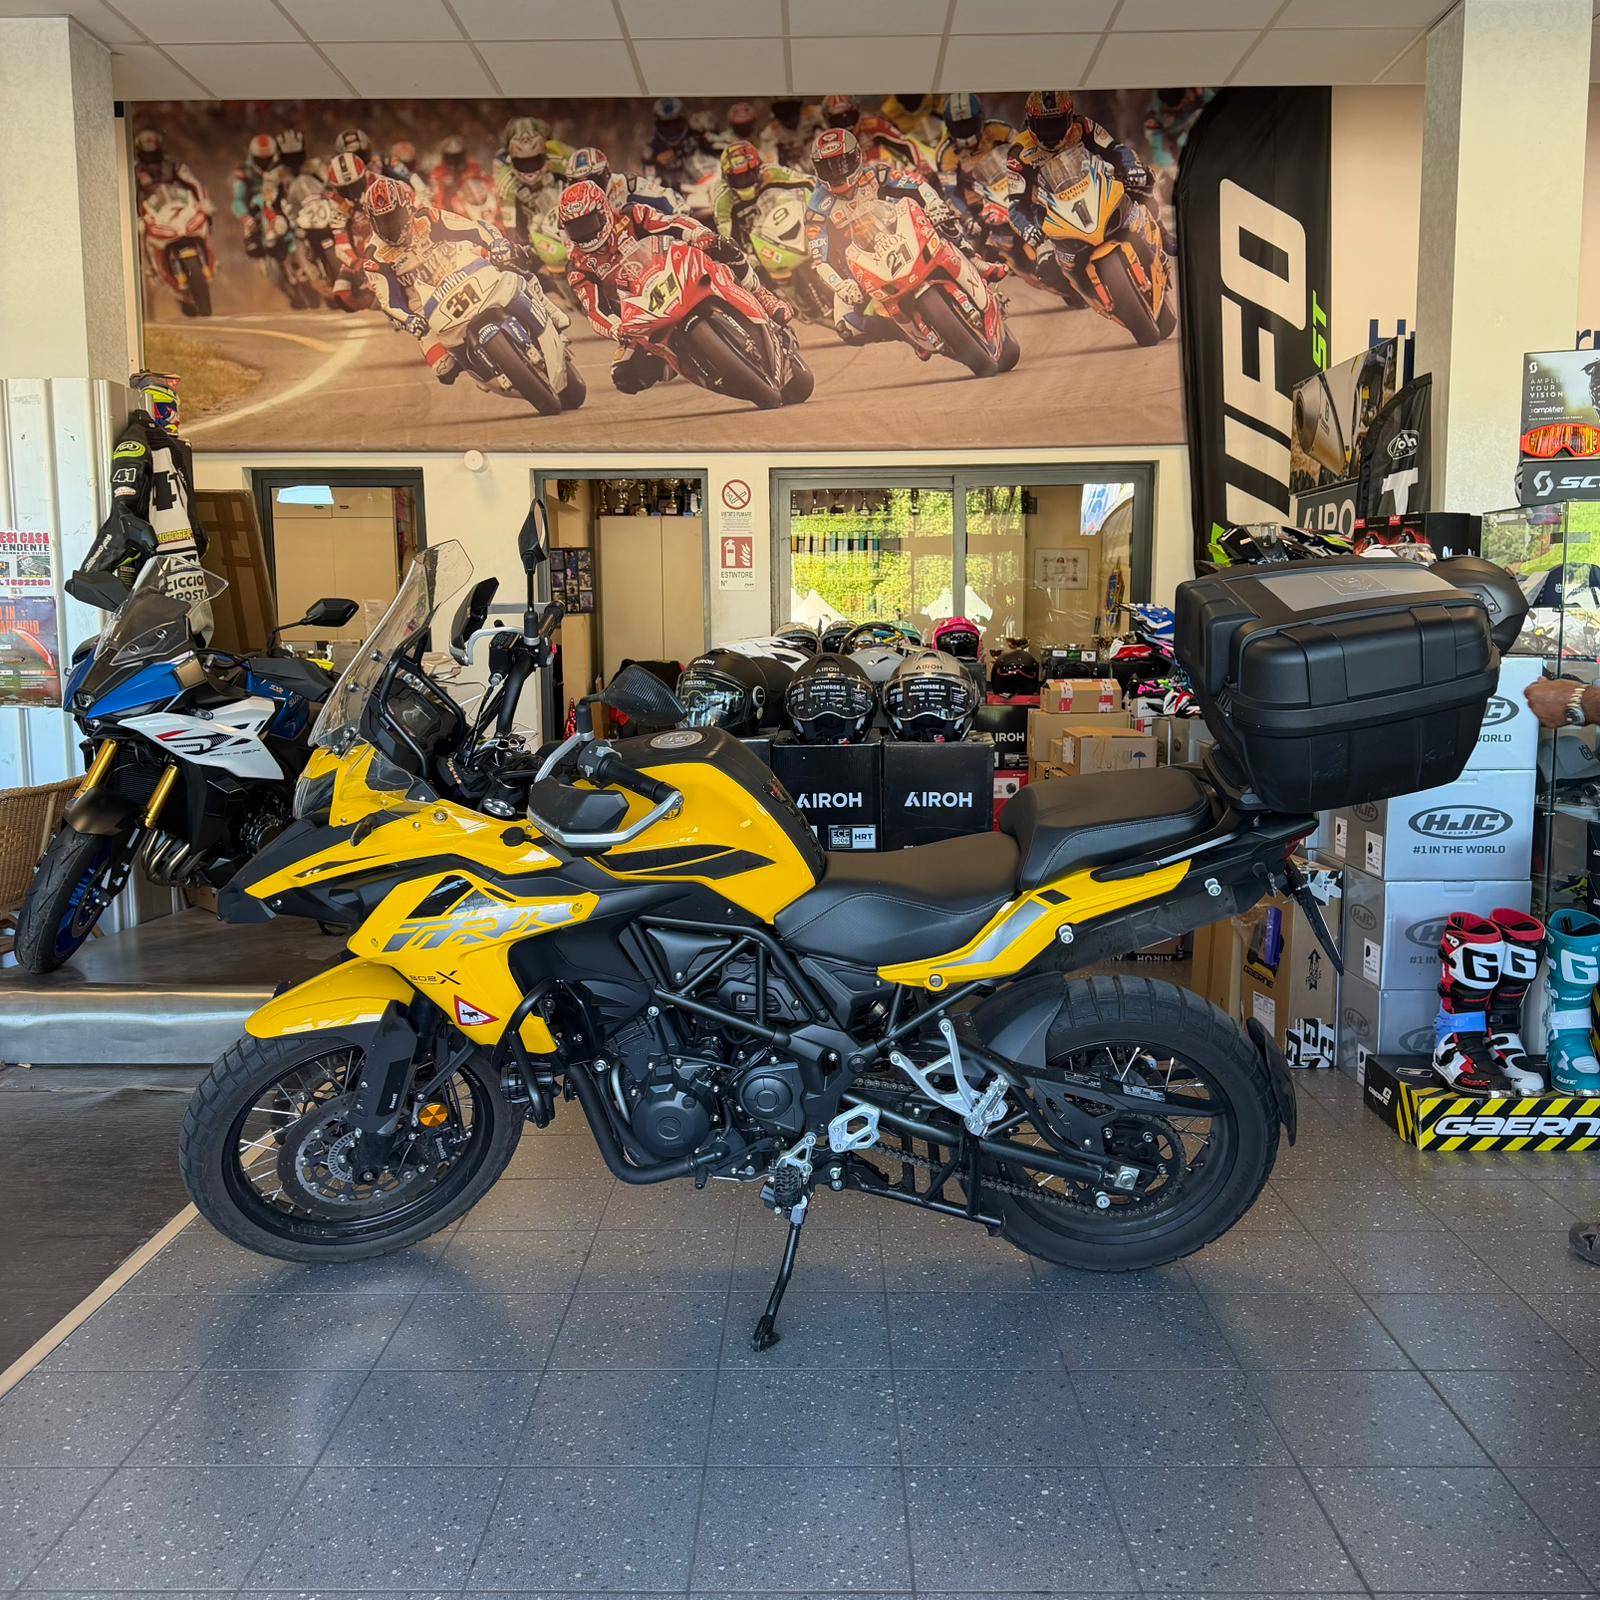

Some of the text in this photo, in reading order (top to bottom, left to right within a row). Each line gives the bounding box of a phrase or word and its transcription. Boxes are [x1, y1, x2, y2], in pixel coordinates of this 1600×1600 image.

[1071, 199, 1095, 228] 1
[886, 243, 915, 279] 21
[444, 284, 480, 319] 31
[1529, 391, 1564, 399] VISION
[112, 468, 137, 483] 41
[20, 532, 50, 544] CASA
[167, 575, 204, 592] CICCIO
[915, 663, 943, 671] AIROH
[797, 792, 863, 809] AIROH
[904, 791, 973, 808] AIROH
[1420, 814, 1502, 831] HJC
[832, 830, 850, 838] ECE
[854, 832, 873, 841] HRT
[1412, 845, 1506, 854] #1 IN THE WORLD
[1425, 955, 1438, 965] IN
[1560, 949, 1598, 985] G
[1435, 1117, 1600, 1136] GAERN
